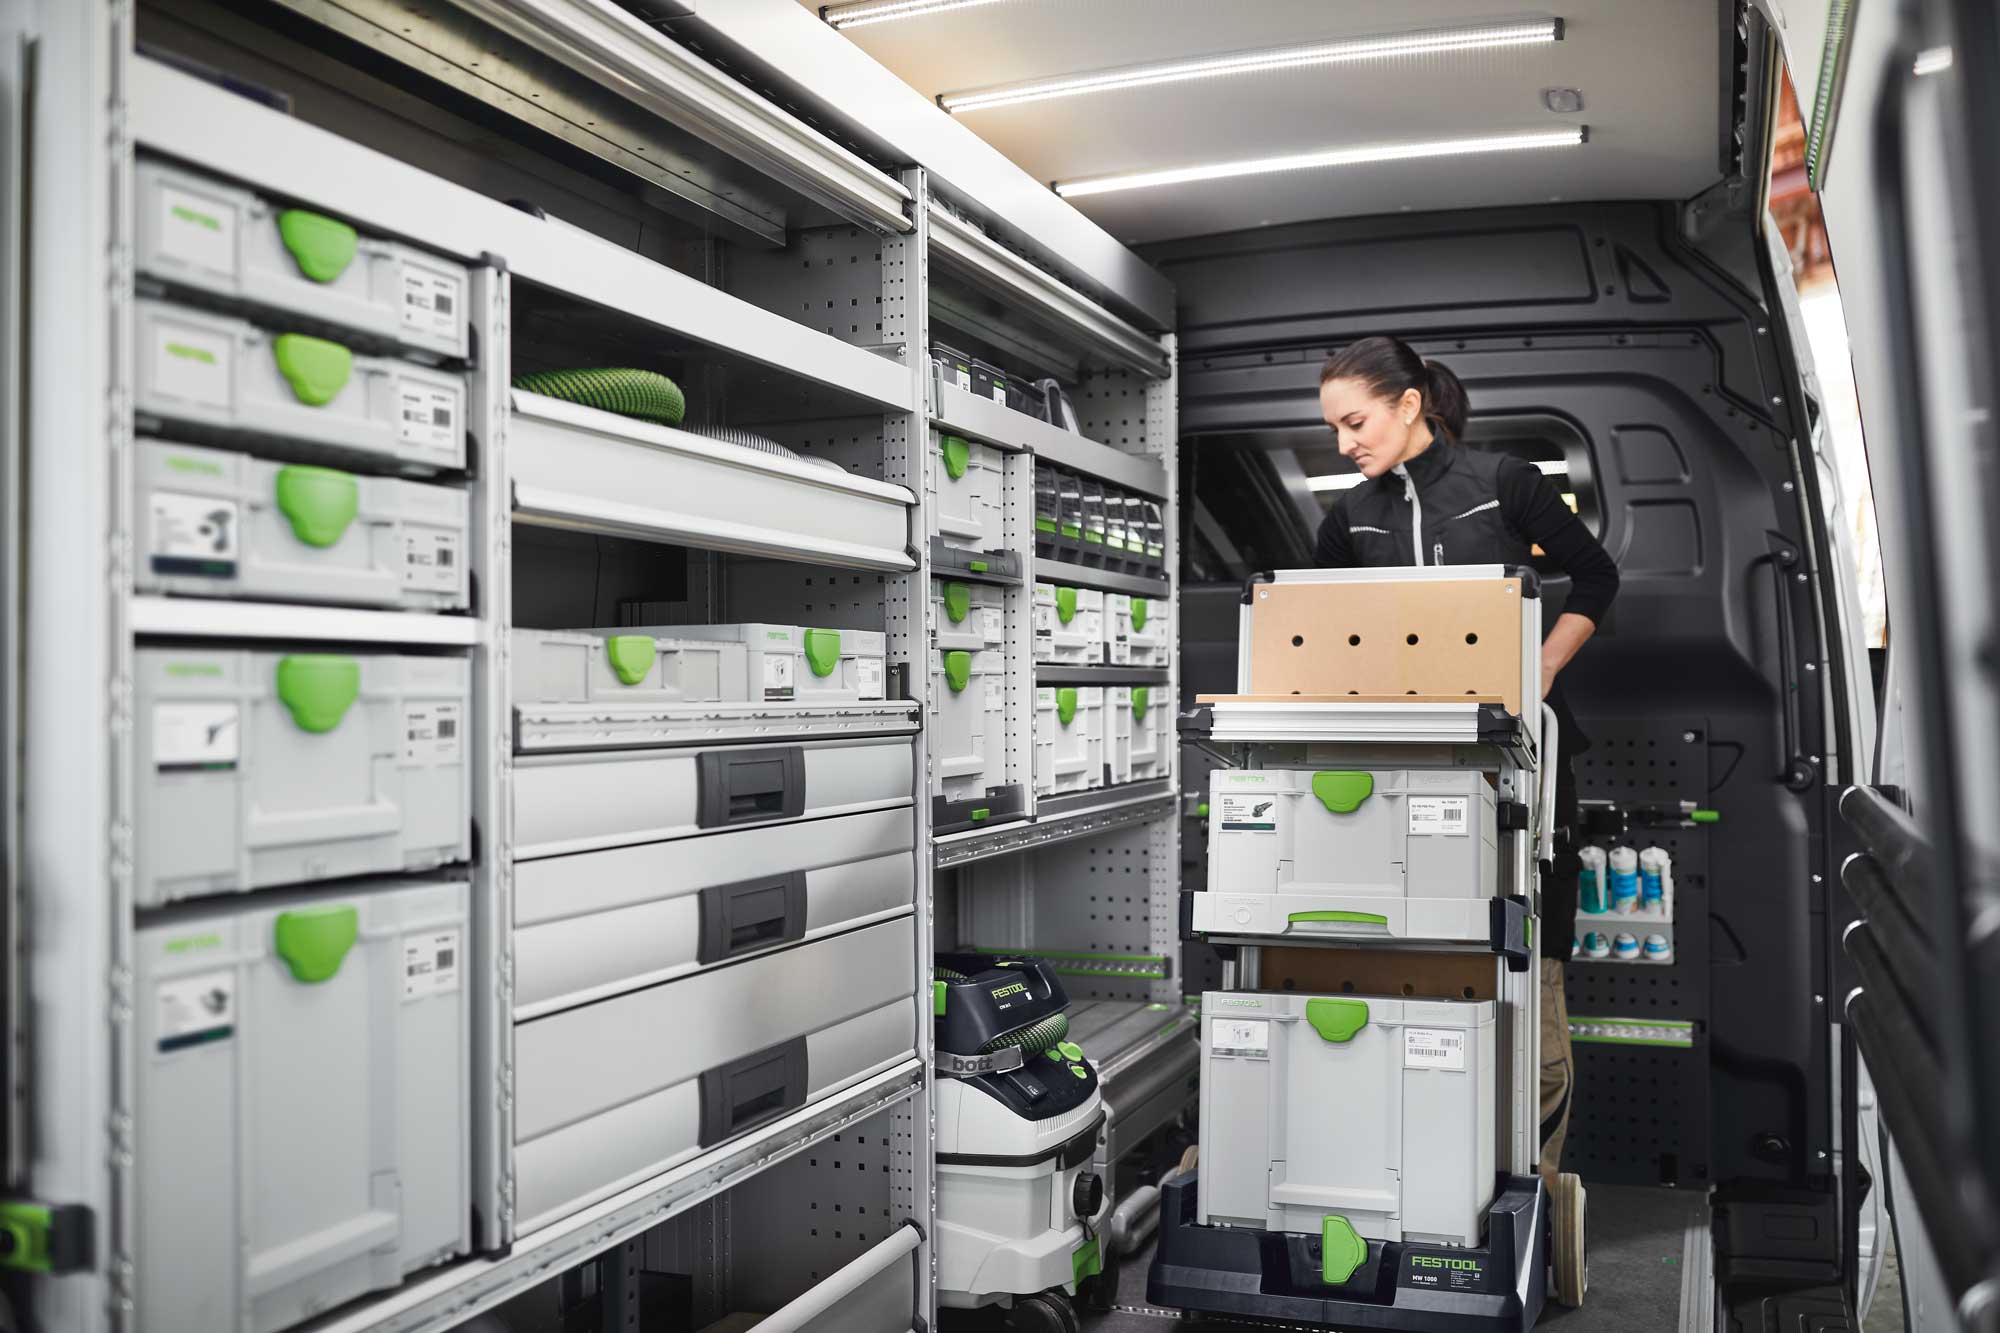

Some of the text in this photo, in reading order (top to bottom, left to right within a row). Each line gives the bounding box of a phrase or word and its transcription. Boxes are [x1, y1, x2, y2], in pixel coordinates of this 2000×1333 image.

[991, 982, 1028, 999] FESTOOL
[952, 1055, 993, 1072] bott
[1411, 1255, 1483, 1272] FESTOOL
